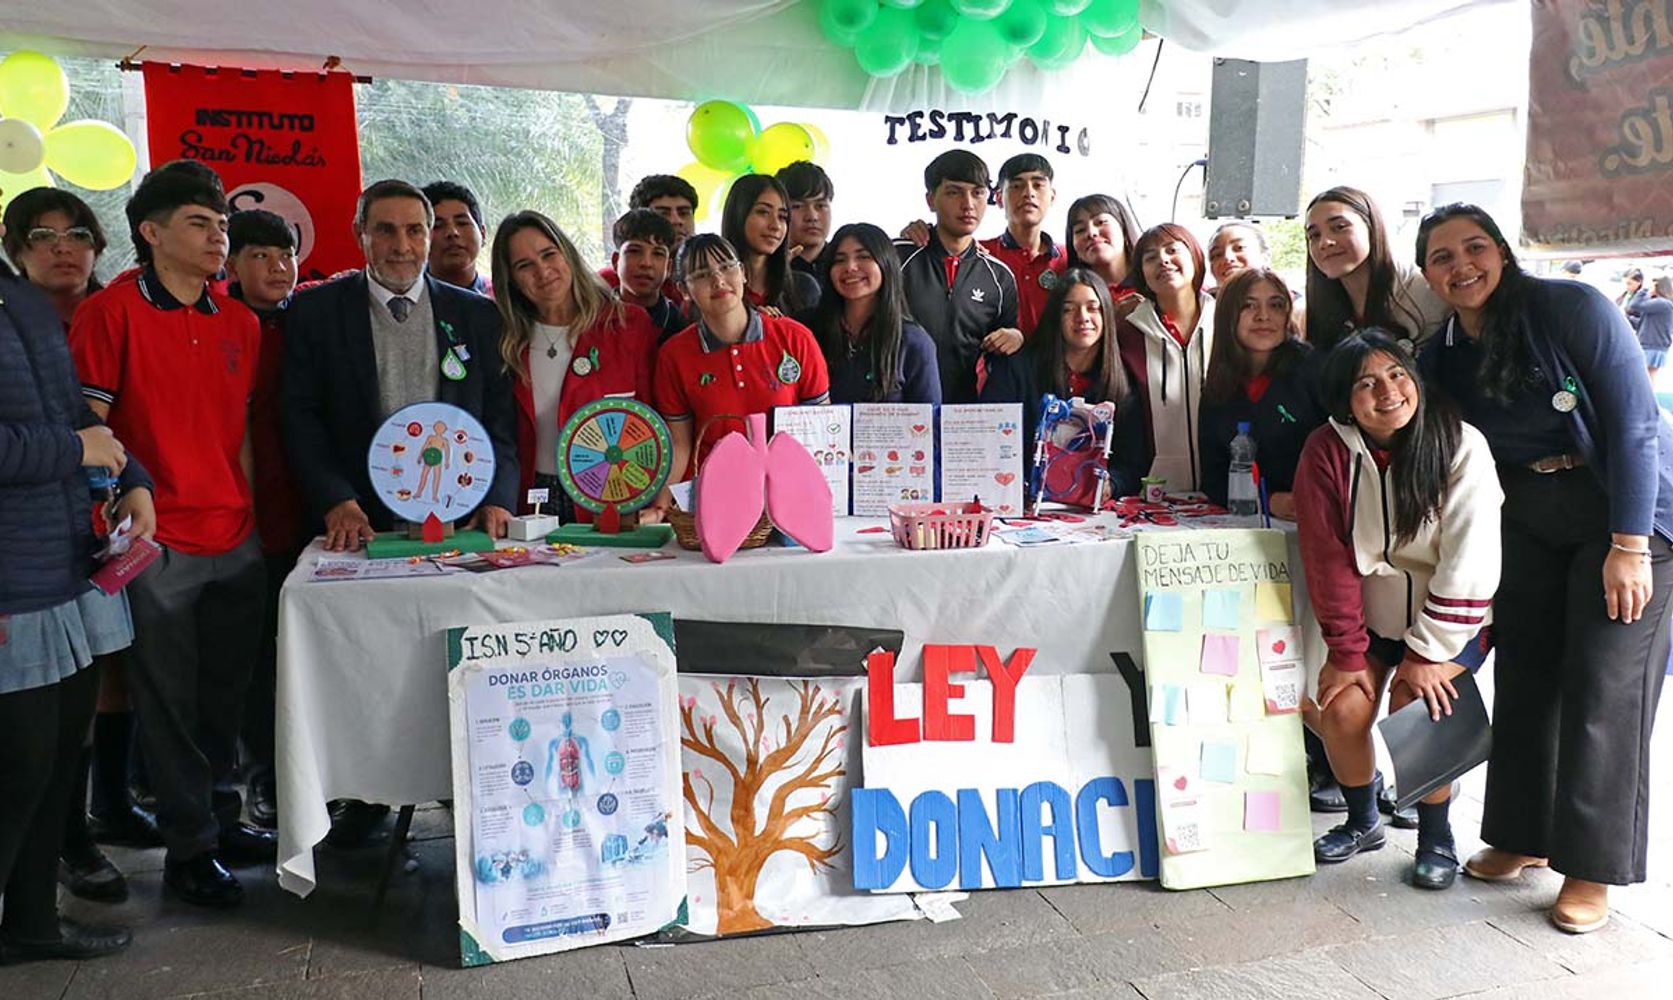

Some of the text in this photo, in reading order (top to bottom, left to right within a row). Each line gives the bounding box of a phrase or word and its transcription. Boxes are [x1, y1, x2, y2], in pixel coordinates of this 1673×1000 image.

[195, 108, 315, 132] INSTITUTO
[179, 130, 236, 161] San
[1142, 542, 1230, 566] DEJA TU
[1144, 562, 1290, 587] MENSAJE DE VIDA
[539, 628, 578, 653] AÑO
[488, 665, 608, 687] DONAR ÓRGANOS
[507, 678, 608, 701] ES DAR VIDA
[867, 644, 1036, 747] LEY
